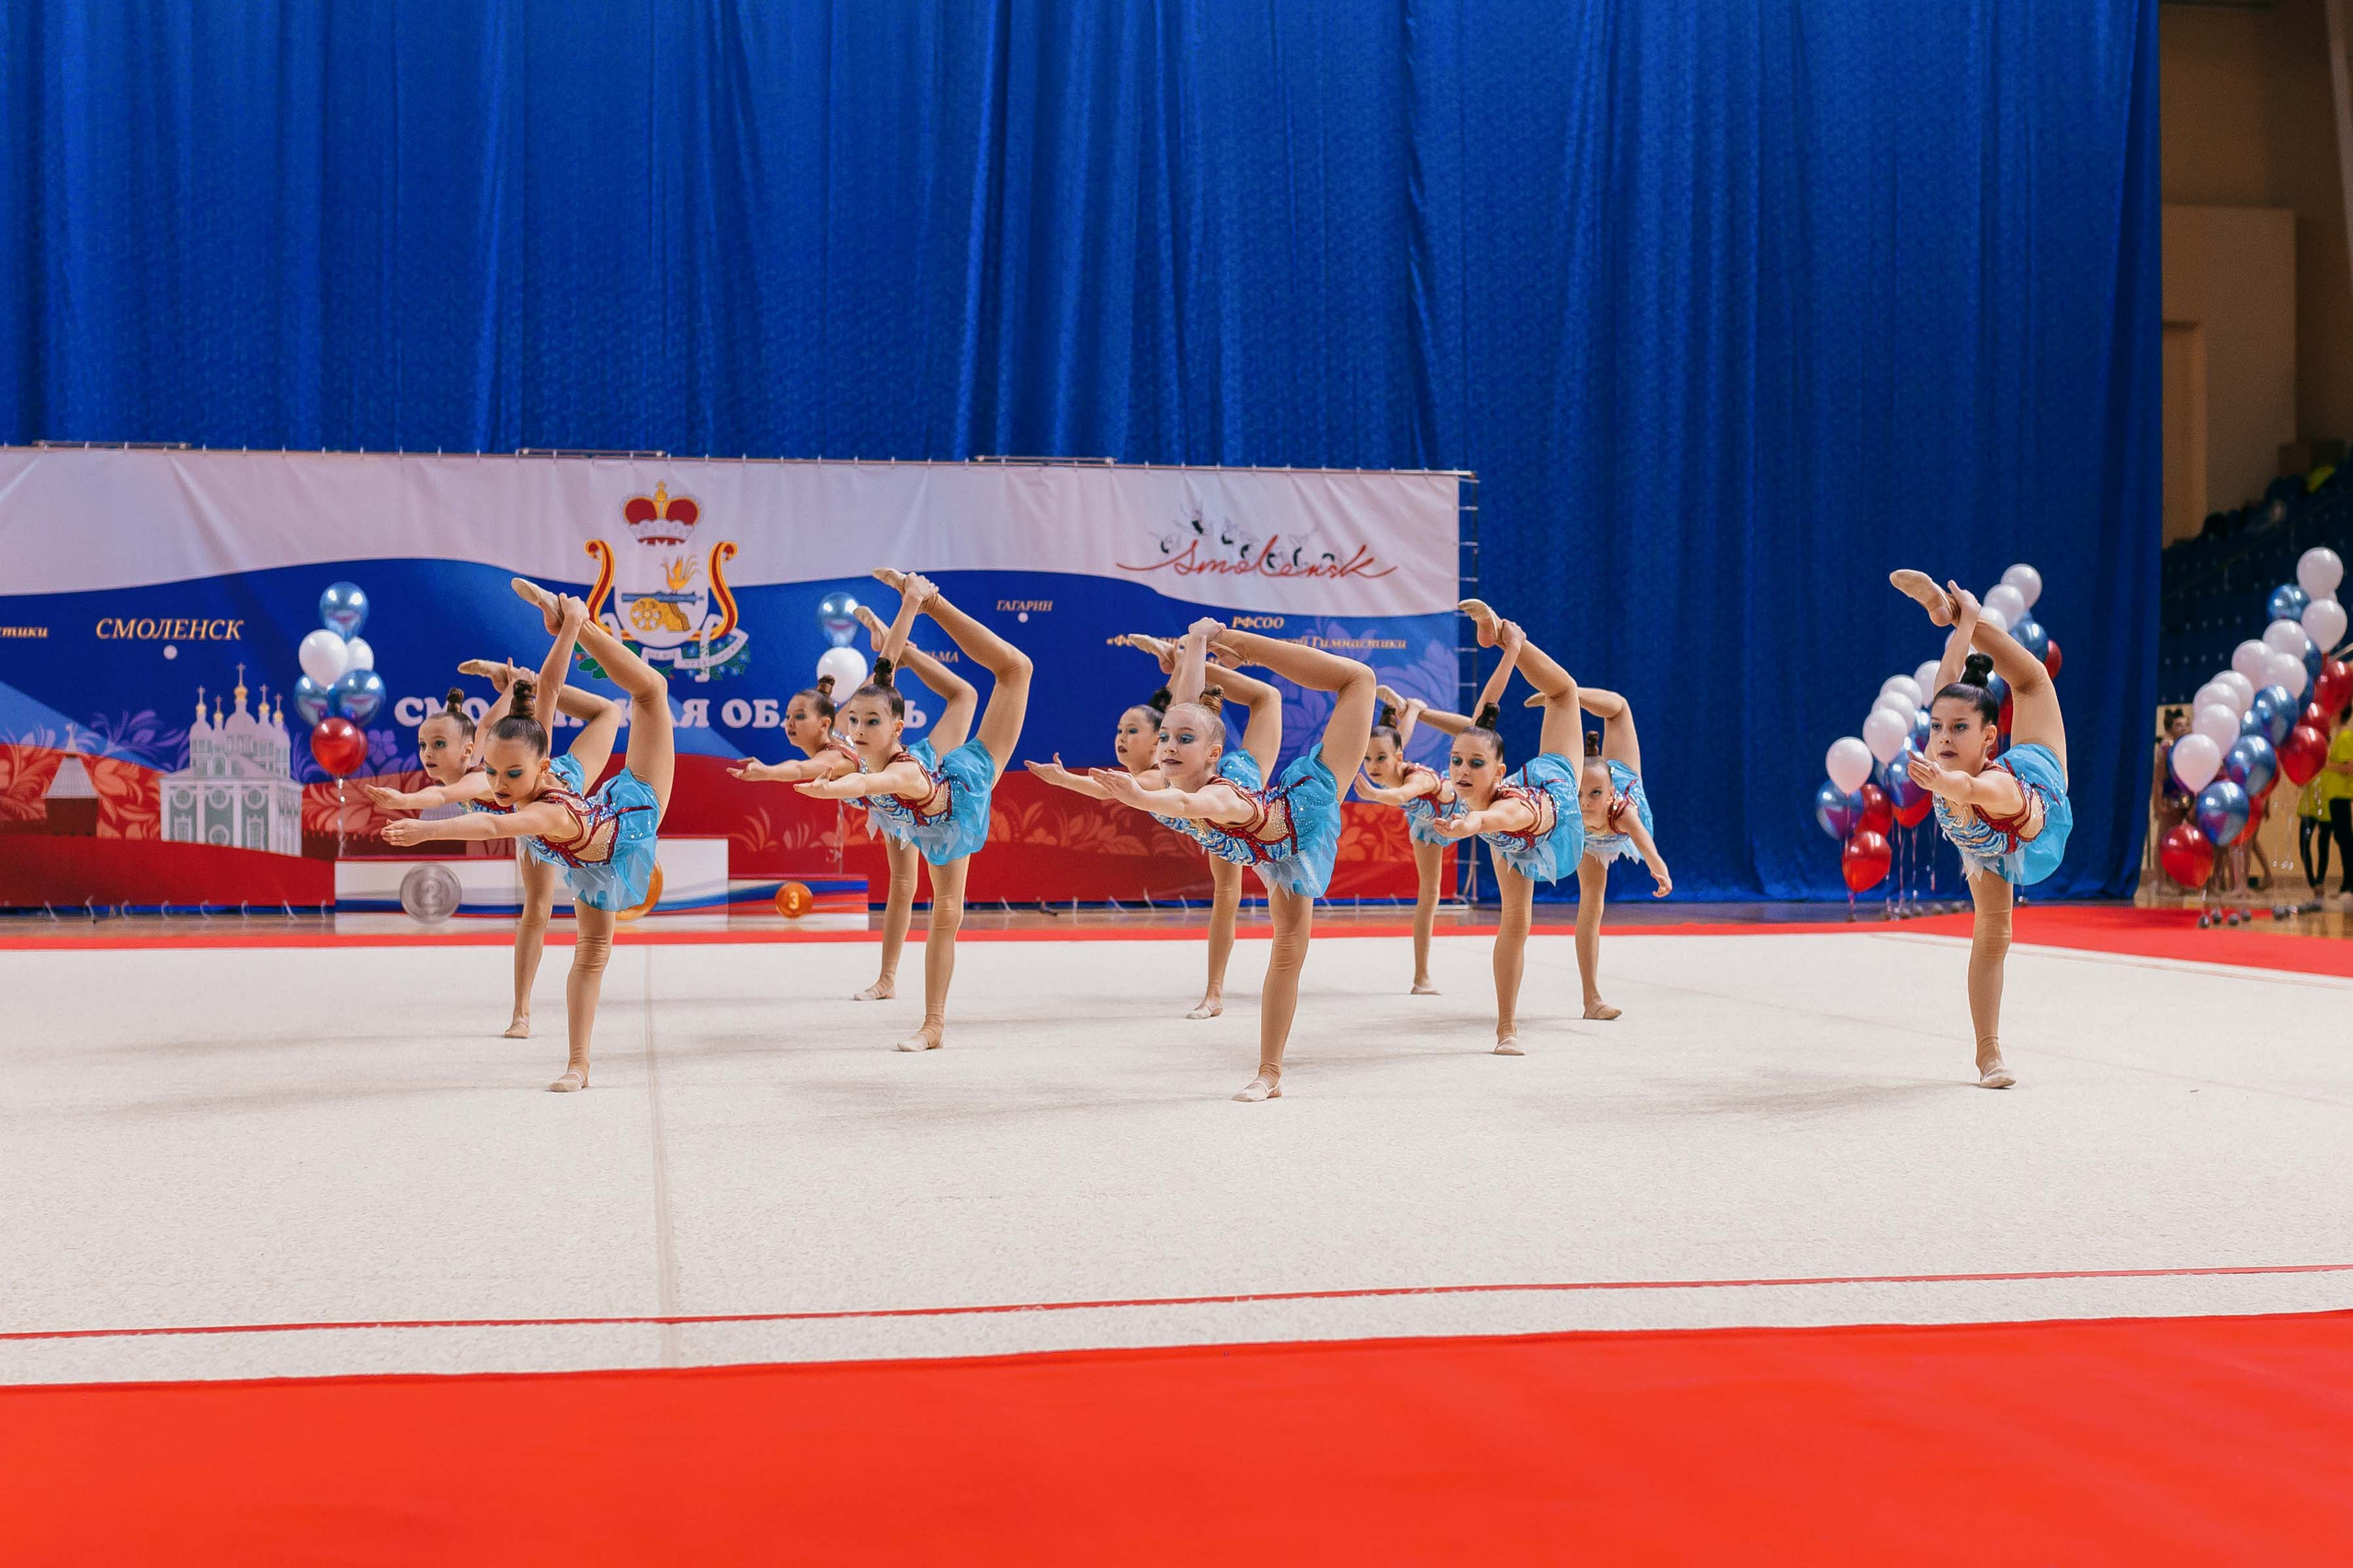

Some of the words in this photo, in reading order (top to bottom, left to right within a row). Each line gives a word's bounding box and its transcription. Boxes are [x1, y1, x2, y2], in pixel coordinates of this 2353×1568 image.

[996, 599, 1053, 611] ГАГАРИН
[96, 618, 244, 641] СМОЛЕНСК
[1232, 616, 1285, 630] РФСОО
[0, 626, 48, 638] тики
[789, 891, 800, 910] 3
